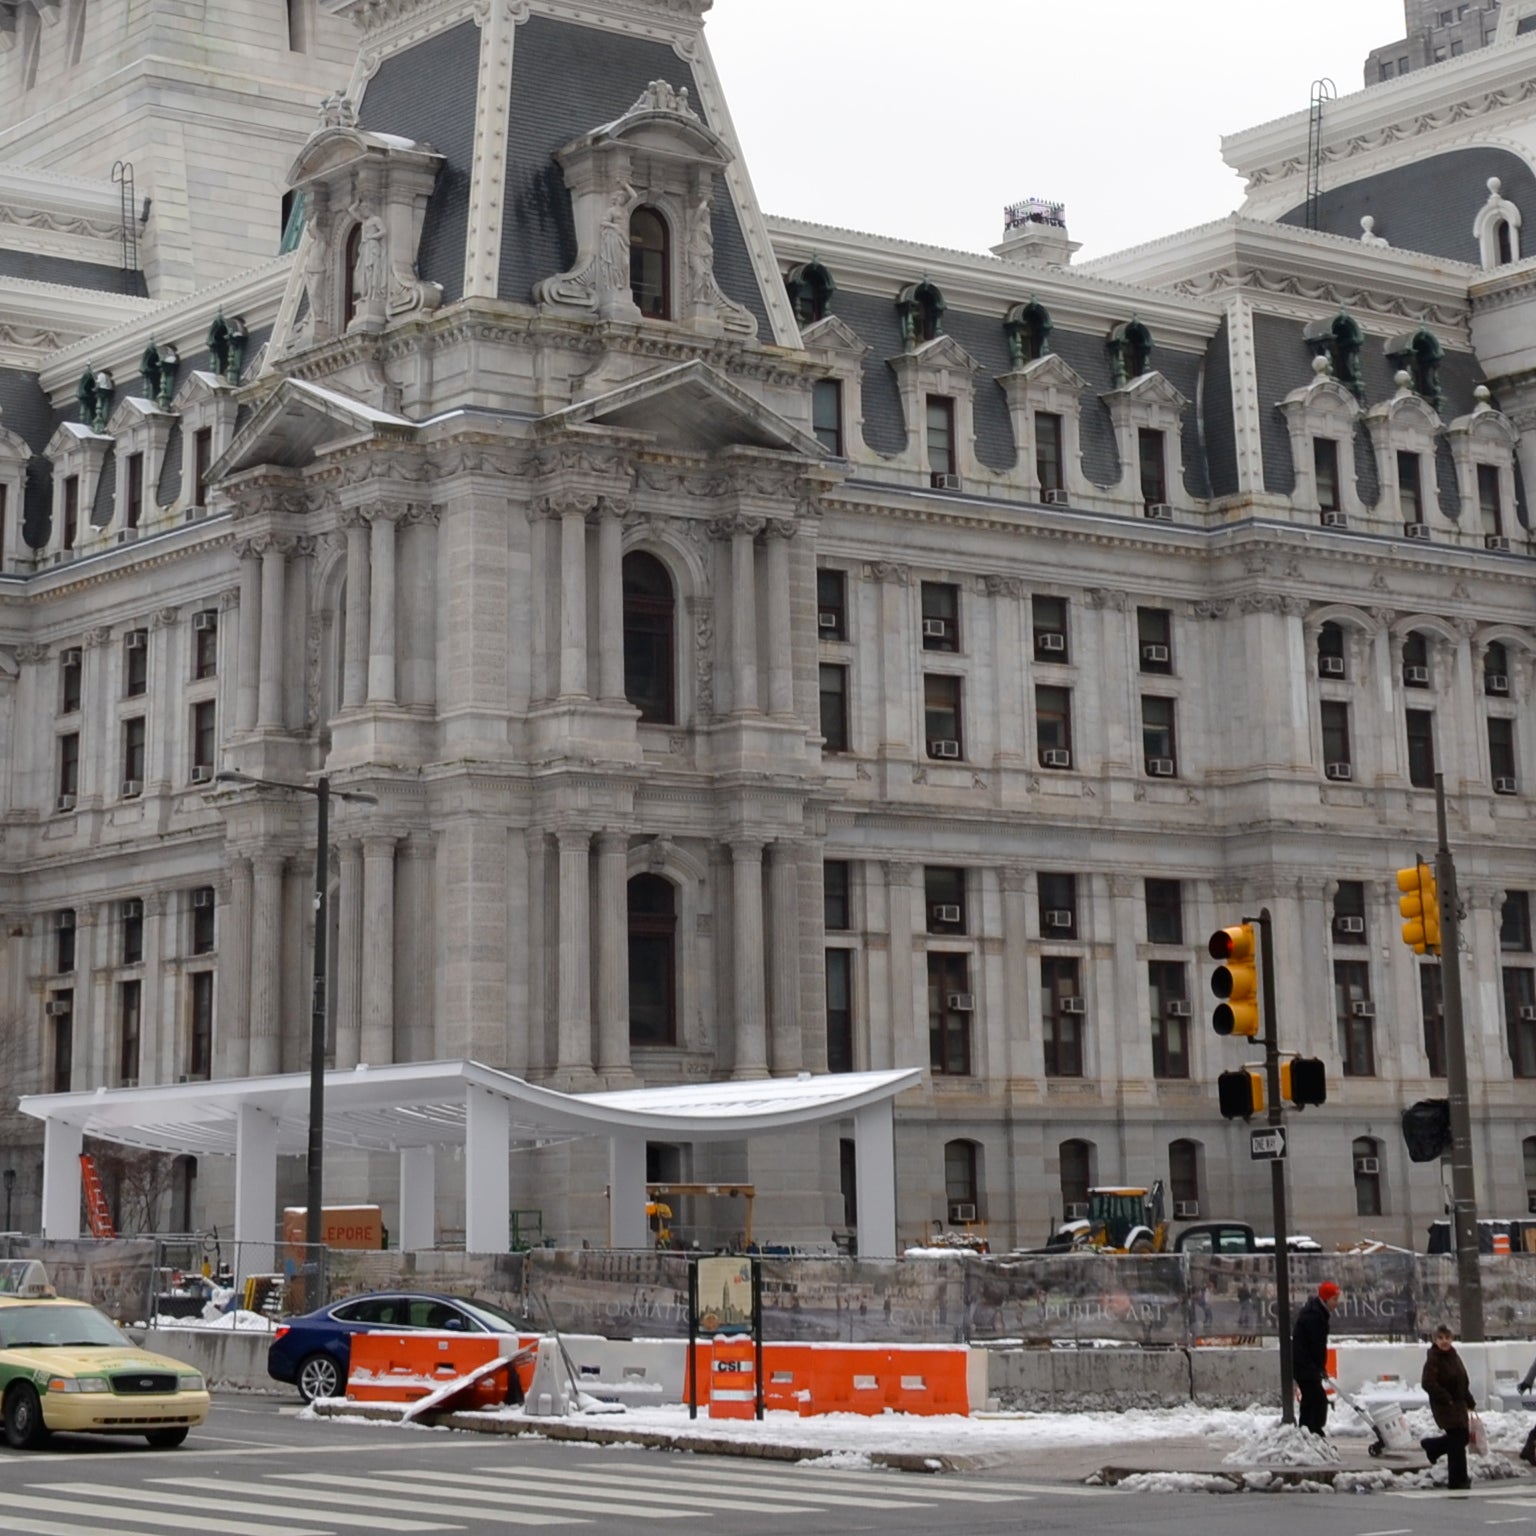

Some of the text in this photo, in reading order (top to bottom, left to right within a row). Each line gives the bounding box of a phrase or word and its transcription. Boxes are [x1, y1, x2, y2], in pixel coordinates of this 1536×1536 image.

[571, 1300, 690, 1323] INFORMATIO
[1044, 1304, 1164, 1322] PUBLIC ART
[717, 1361, 742, 1373] CSI
